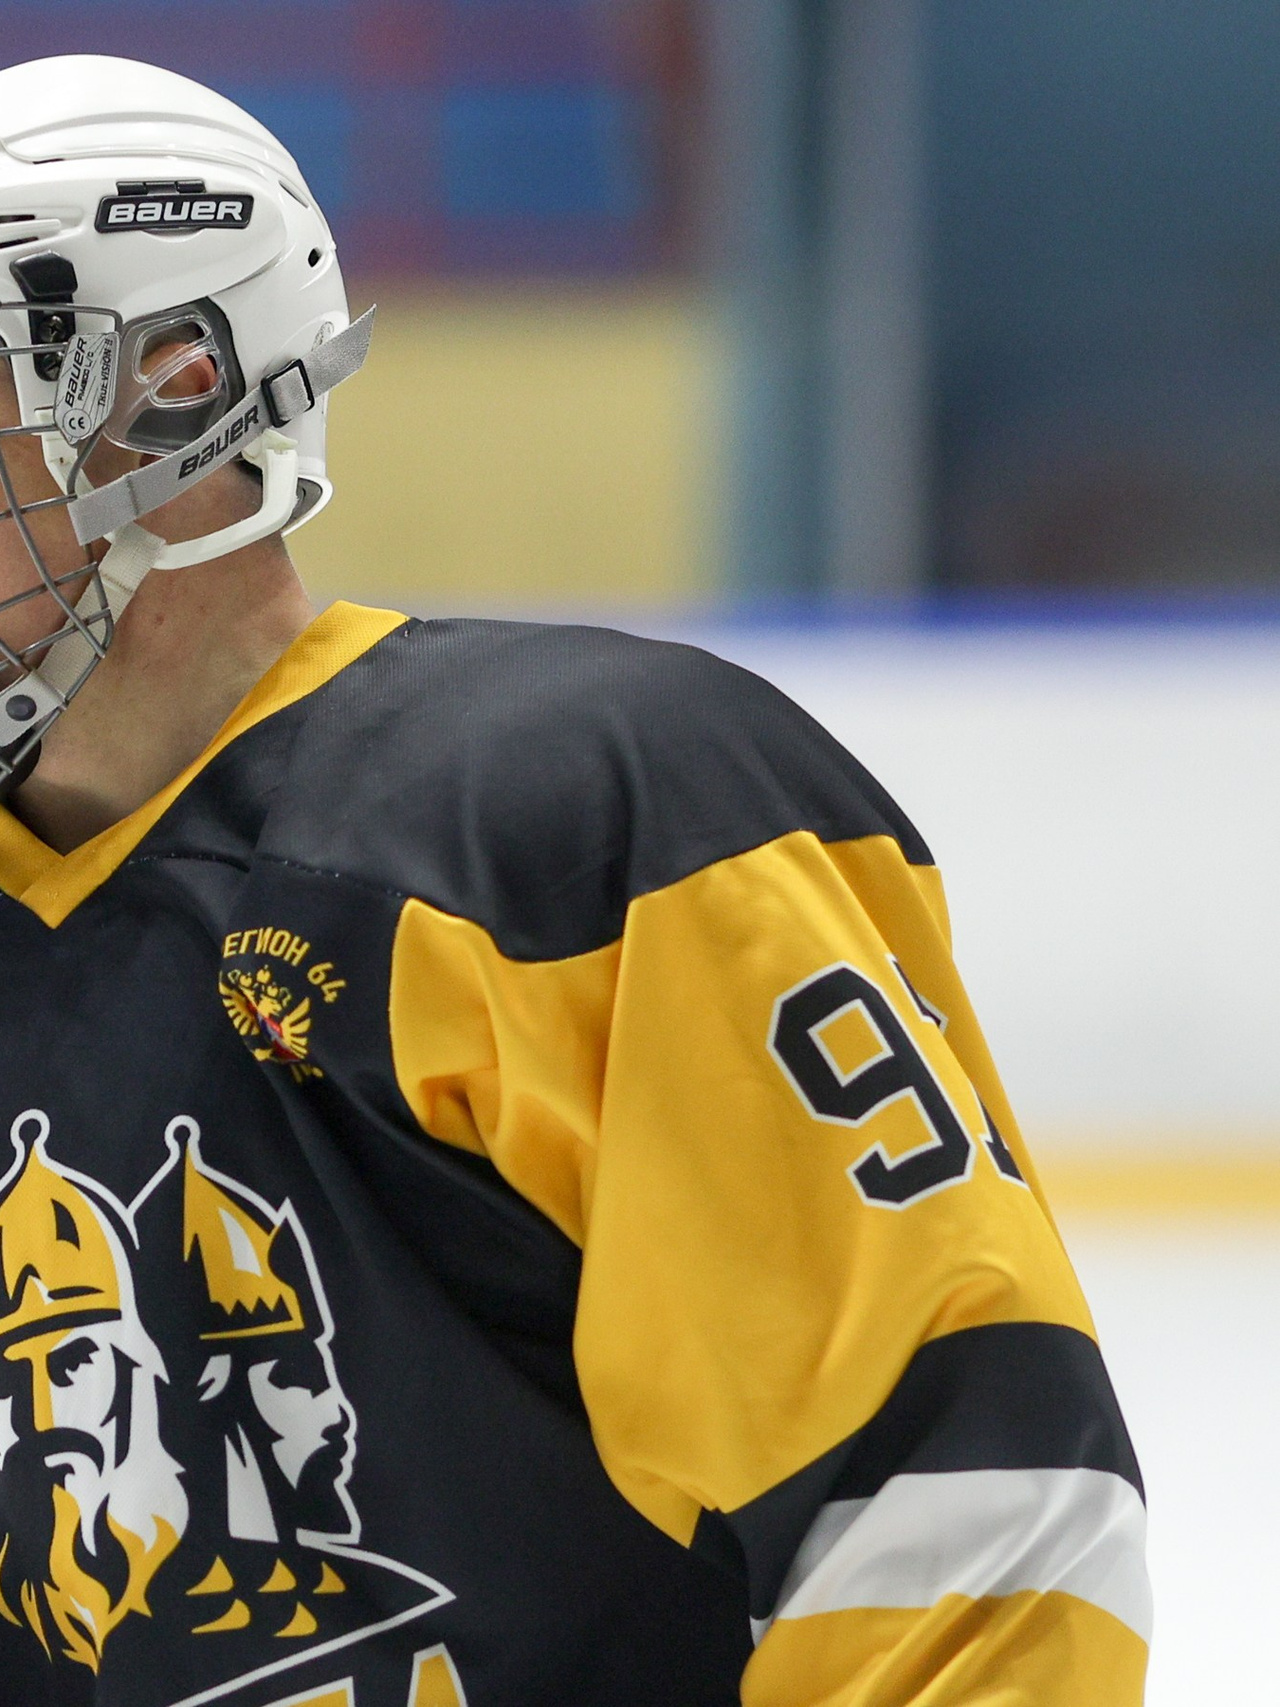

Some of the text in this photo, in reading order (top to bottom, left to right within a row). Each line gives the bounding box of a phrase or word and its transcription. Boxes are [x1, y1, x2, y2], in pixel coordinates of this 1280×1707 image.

[107, 200, 244, 224] BAUER
[64, 337, 88, 408] BAUER
[101, 348, 112, 381] VISION
[177, 404, 259, 480] BAUER
[222, 926, 348, 1004] ЕГИОН 64
